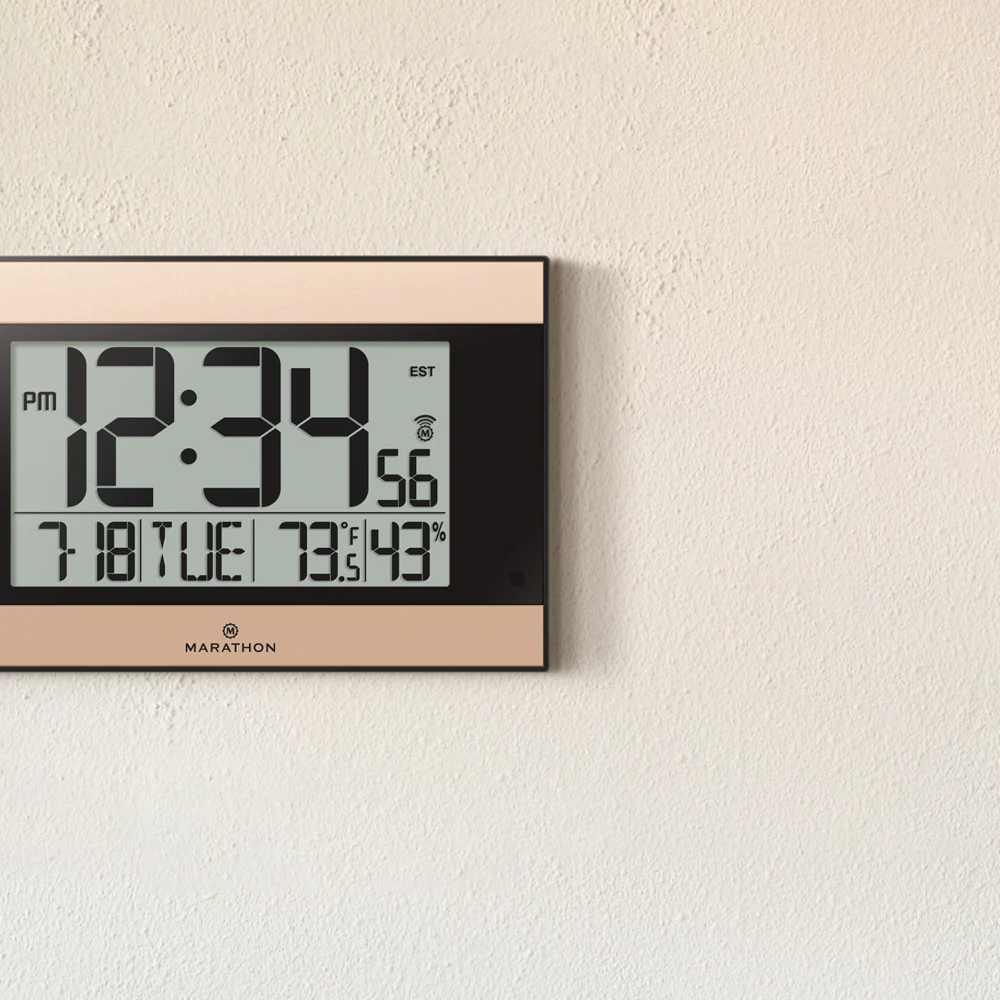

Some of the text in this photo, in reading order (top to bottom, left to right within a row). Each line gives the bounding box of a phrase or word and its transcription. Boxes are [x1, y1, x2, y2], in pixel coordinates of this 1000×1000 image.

[410, 366, 436, 377] EST
[23, 391, 57, 411] PM
[67, 347, 369, 508] 12:34
[377, 448, 438, 508] 56
[152, 521, 245, 582] TUE
[185, 643, 276, 653] MARATHON
